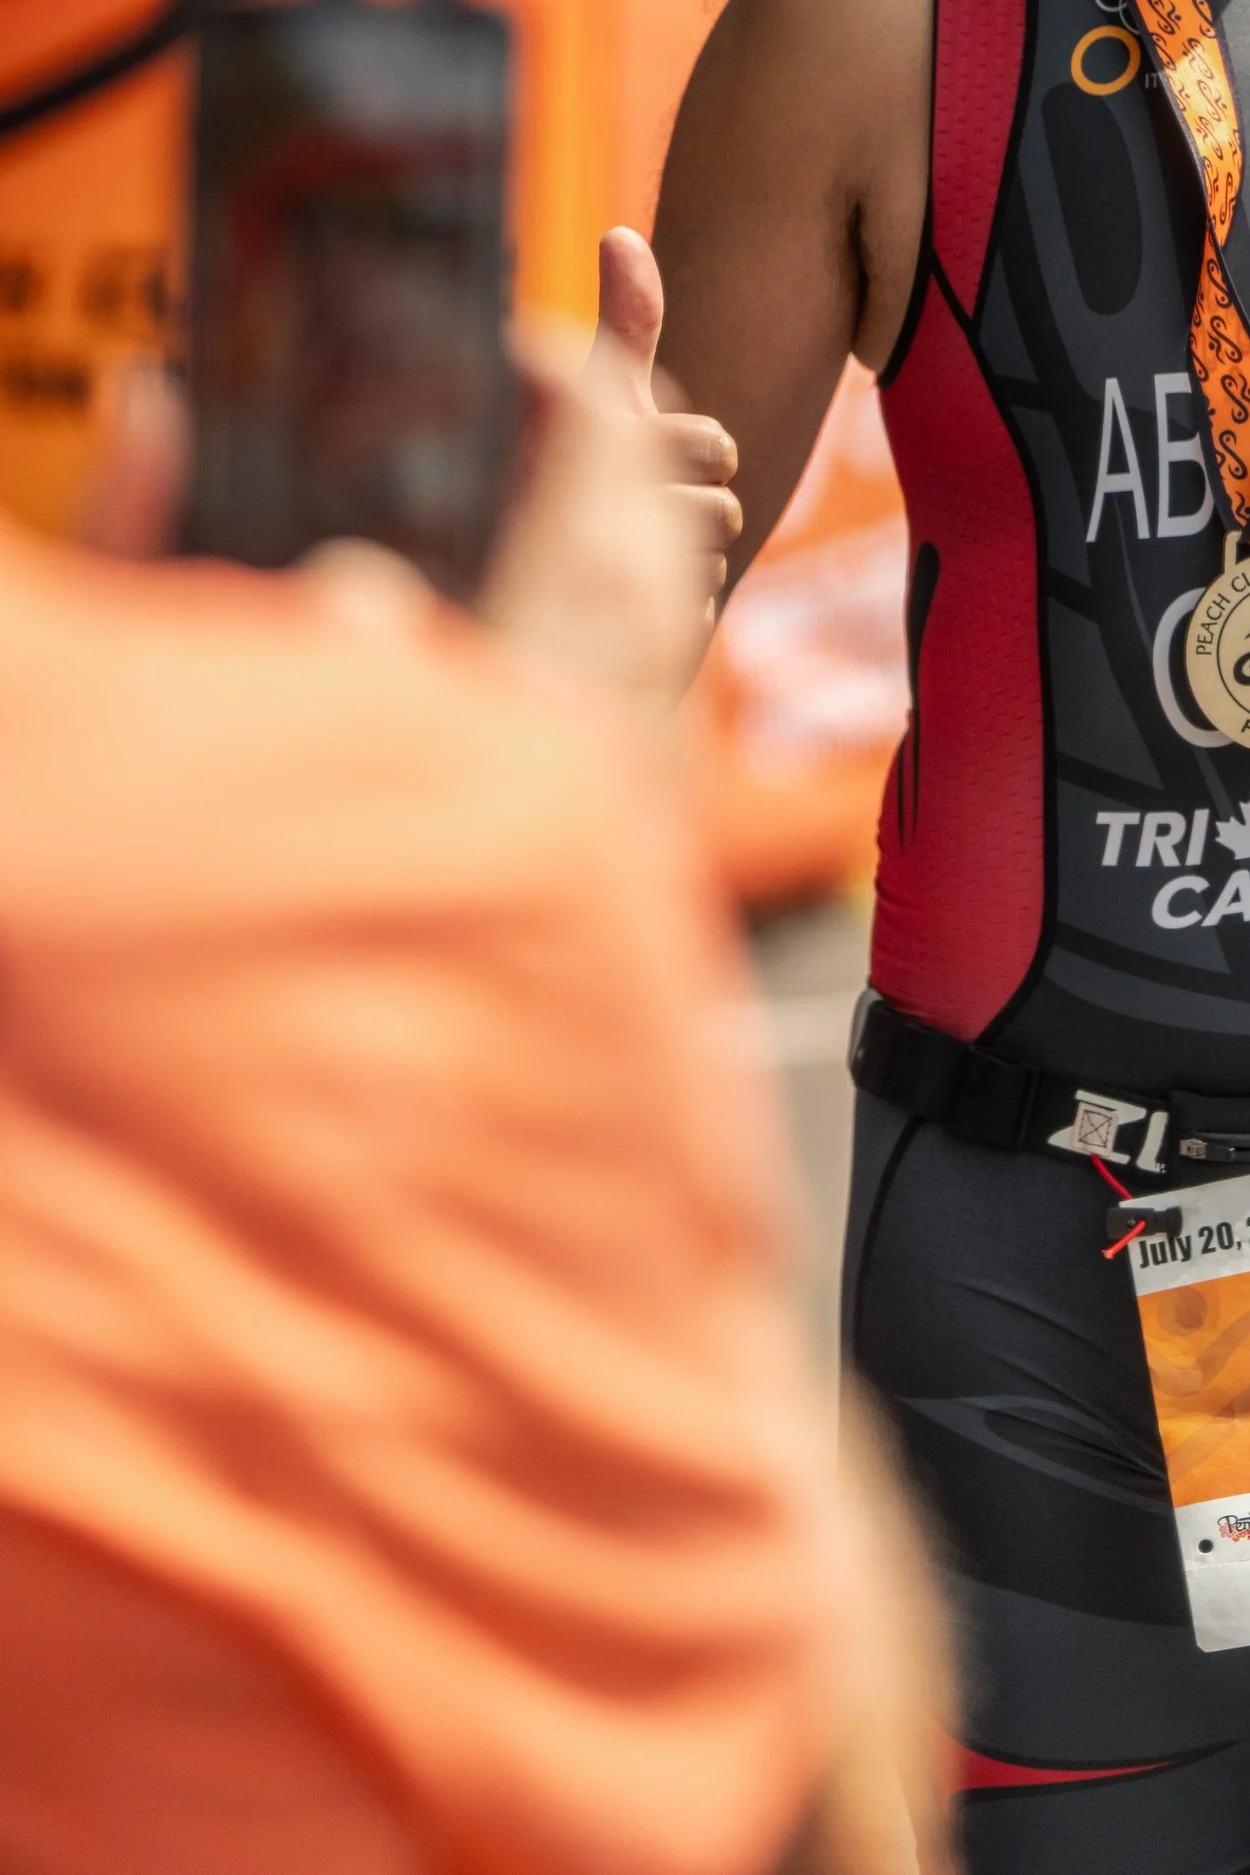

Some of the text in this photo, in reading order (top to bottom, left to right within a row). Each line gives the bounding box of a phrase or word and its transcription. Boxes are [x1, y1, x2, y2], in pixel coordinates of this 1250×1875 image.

[1195, 593, 1231, 656] PEACH
[1139, 1235, 1192, 1268] July
[1198, 1221, 1241, 1255] 20,
